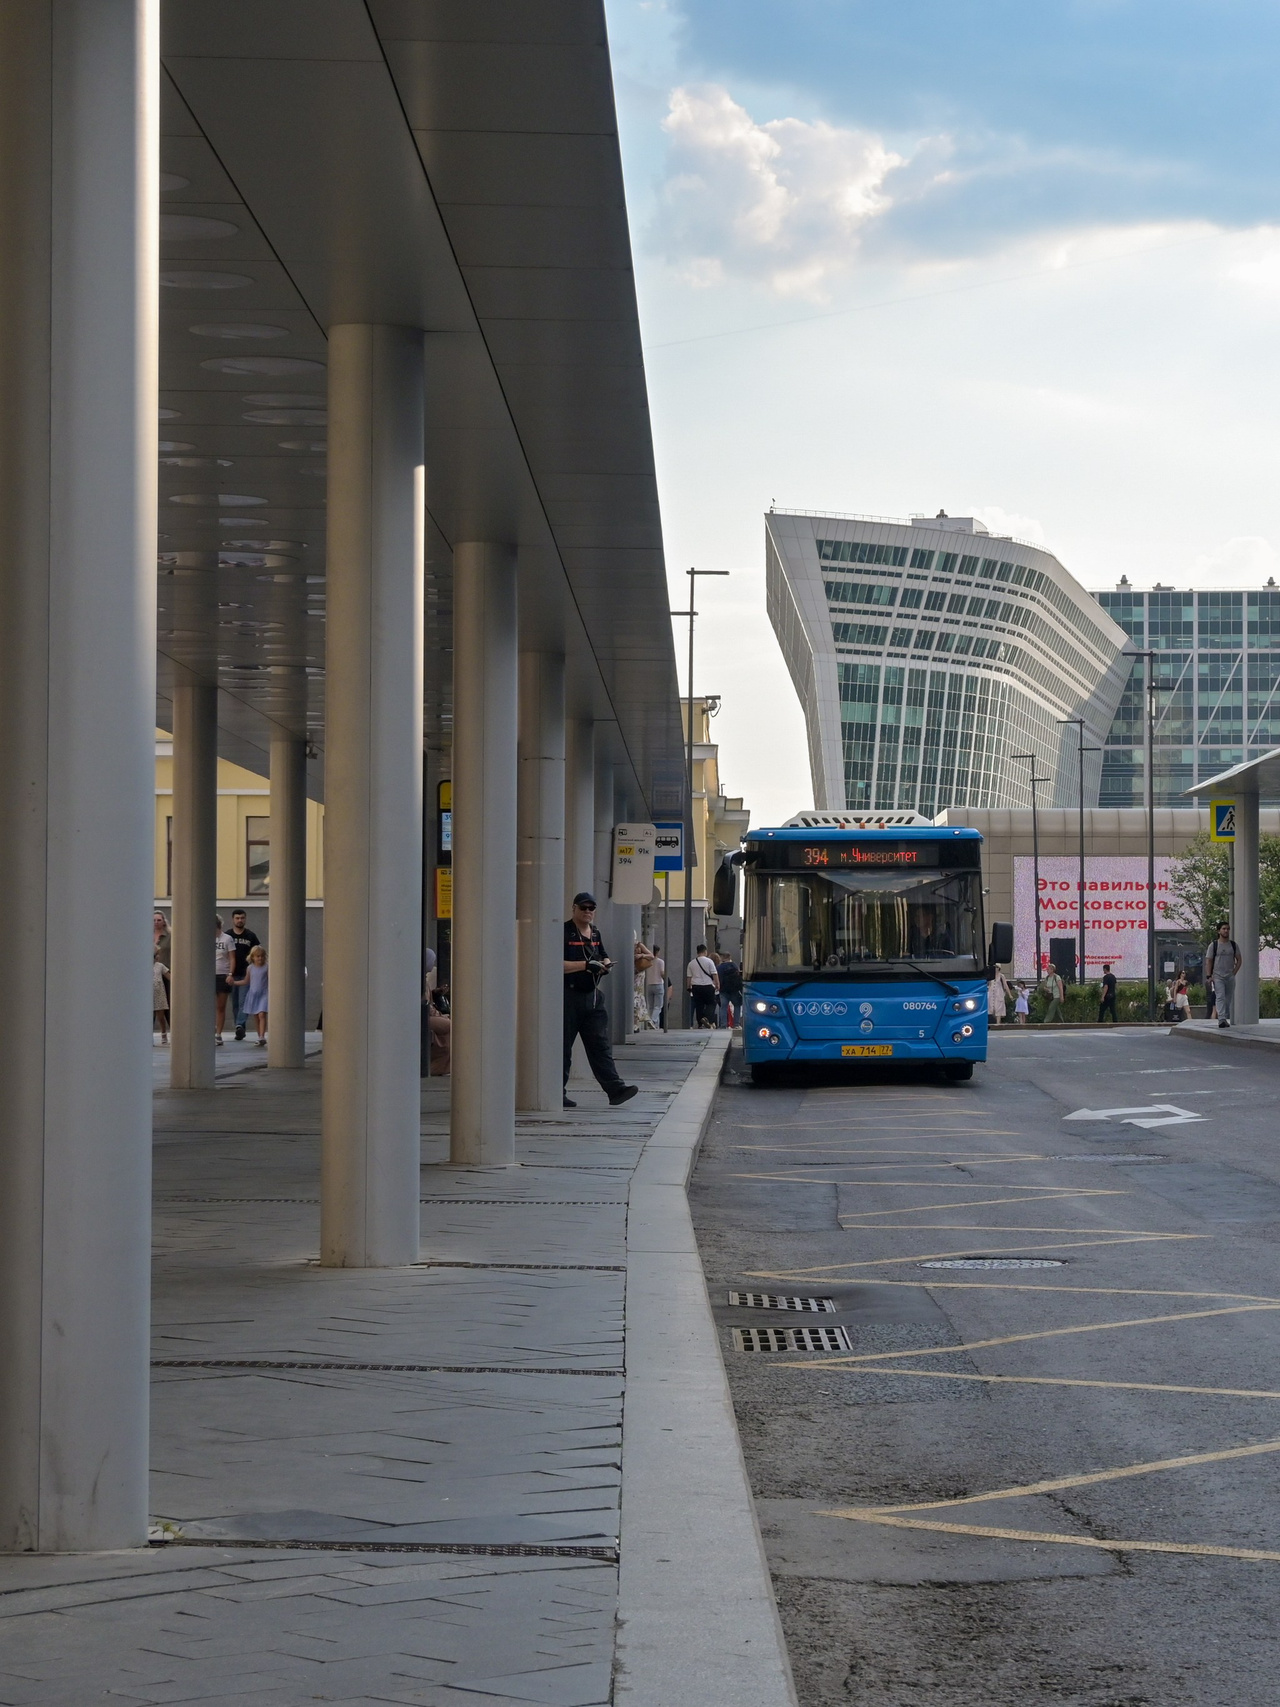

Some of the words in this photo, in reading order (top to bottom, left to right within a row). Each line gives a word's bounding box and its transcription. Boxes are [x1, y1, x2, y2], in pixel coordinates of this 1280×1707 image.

[618, 857, 632, 865] 394
[804, 848, 829, 865] 394
[1037, 878, 1071, 891] Это
[1038, 897, 1169, 911] Московскоо
[902, 1002, 938, 1011] 080764
[918, 1030, 925, 1038] 5
[860, 1046, 877, 1055] 714
[880, 1045, 890, 1053] 77
